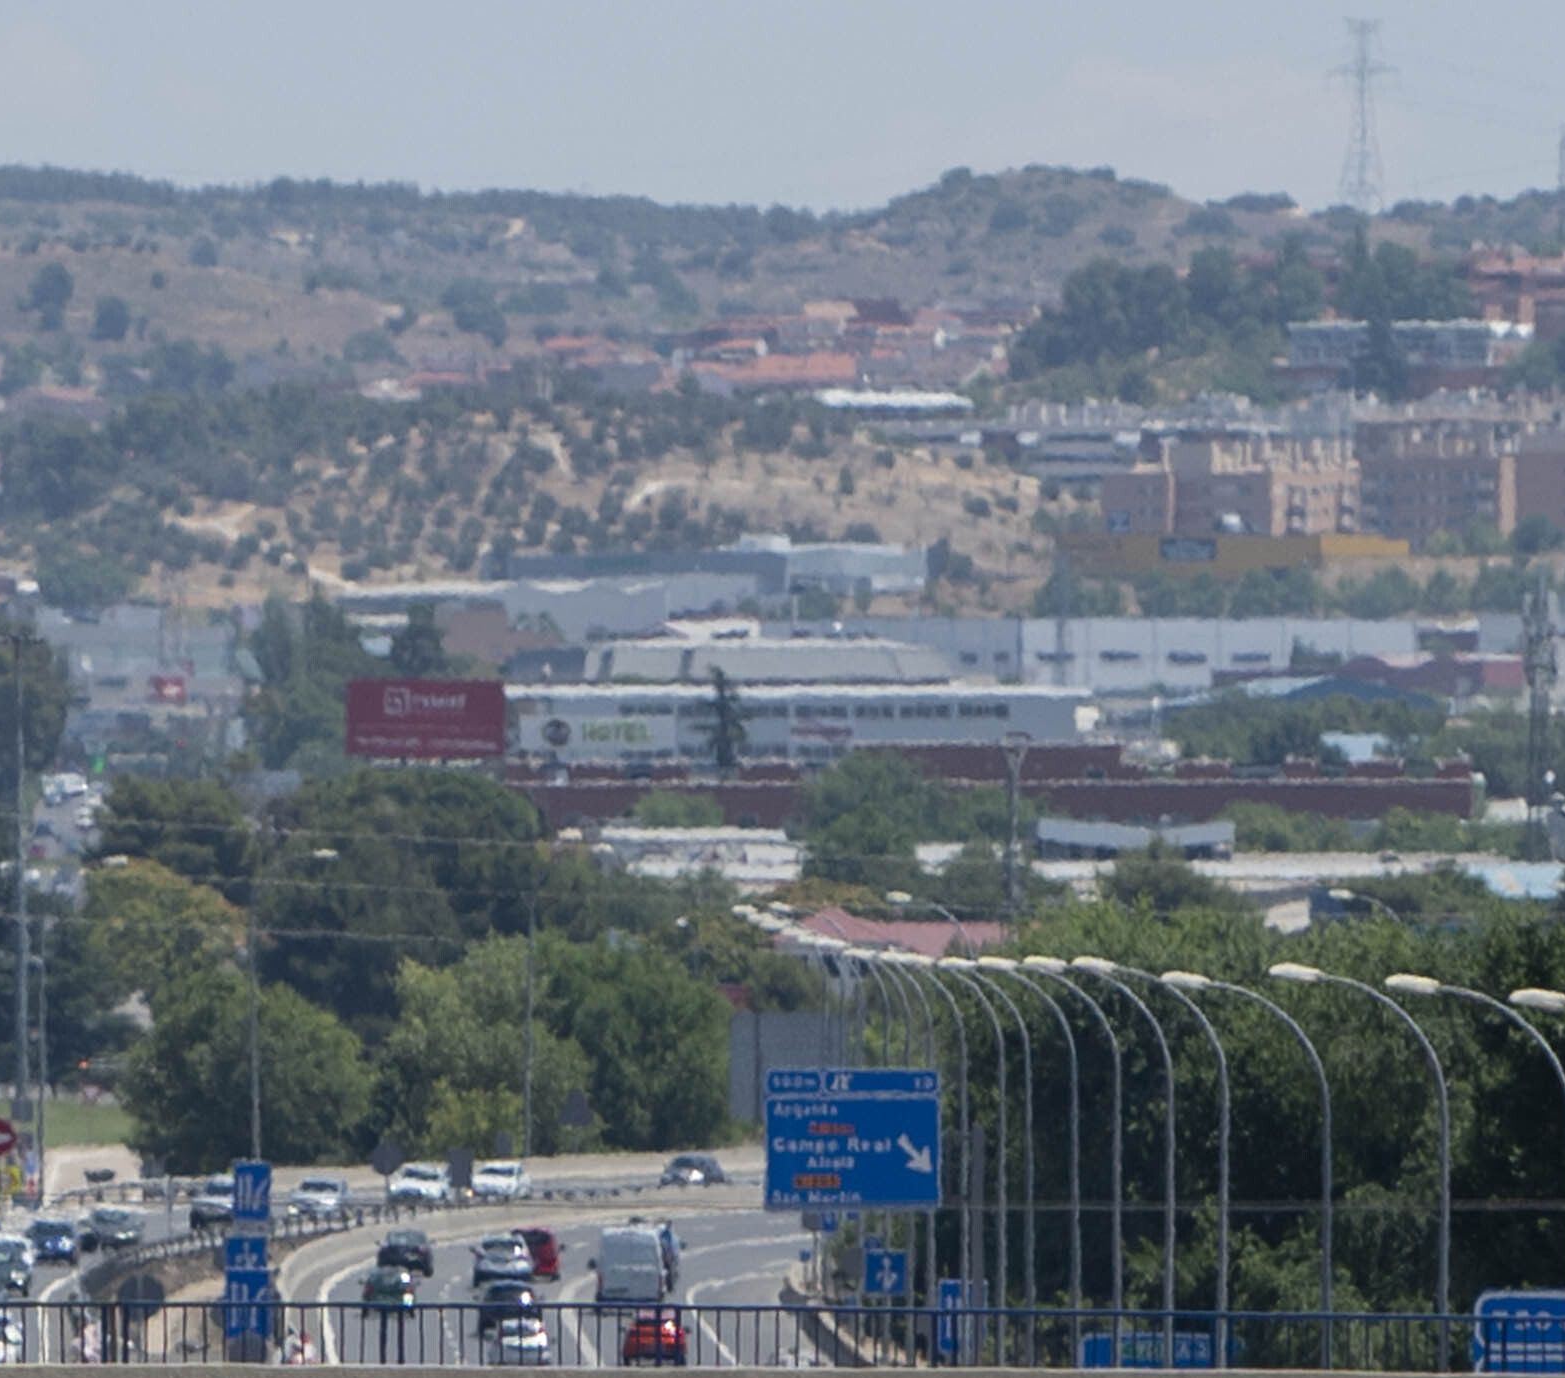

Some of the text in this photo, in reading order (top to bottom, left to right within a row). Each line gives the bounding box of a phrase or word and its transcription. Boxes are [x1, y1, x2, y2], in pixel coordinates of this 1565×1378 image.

[582, 720, 651, 742] HOTEL
[773, 1137, 892, 1154] Campo Real
